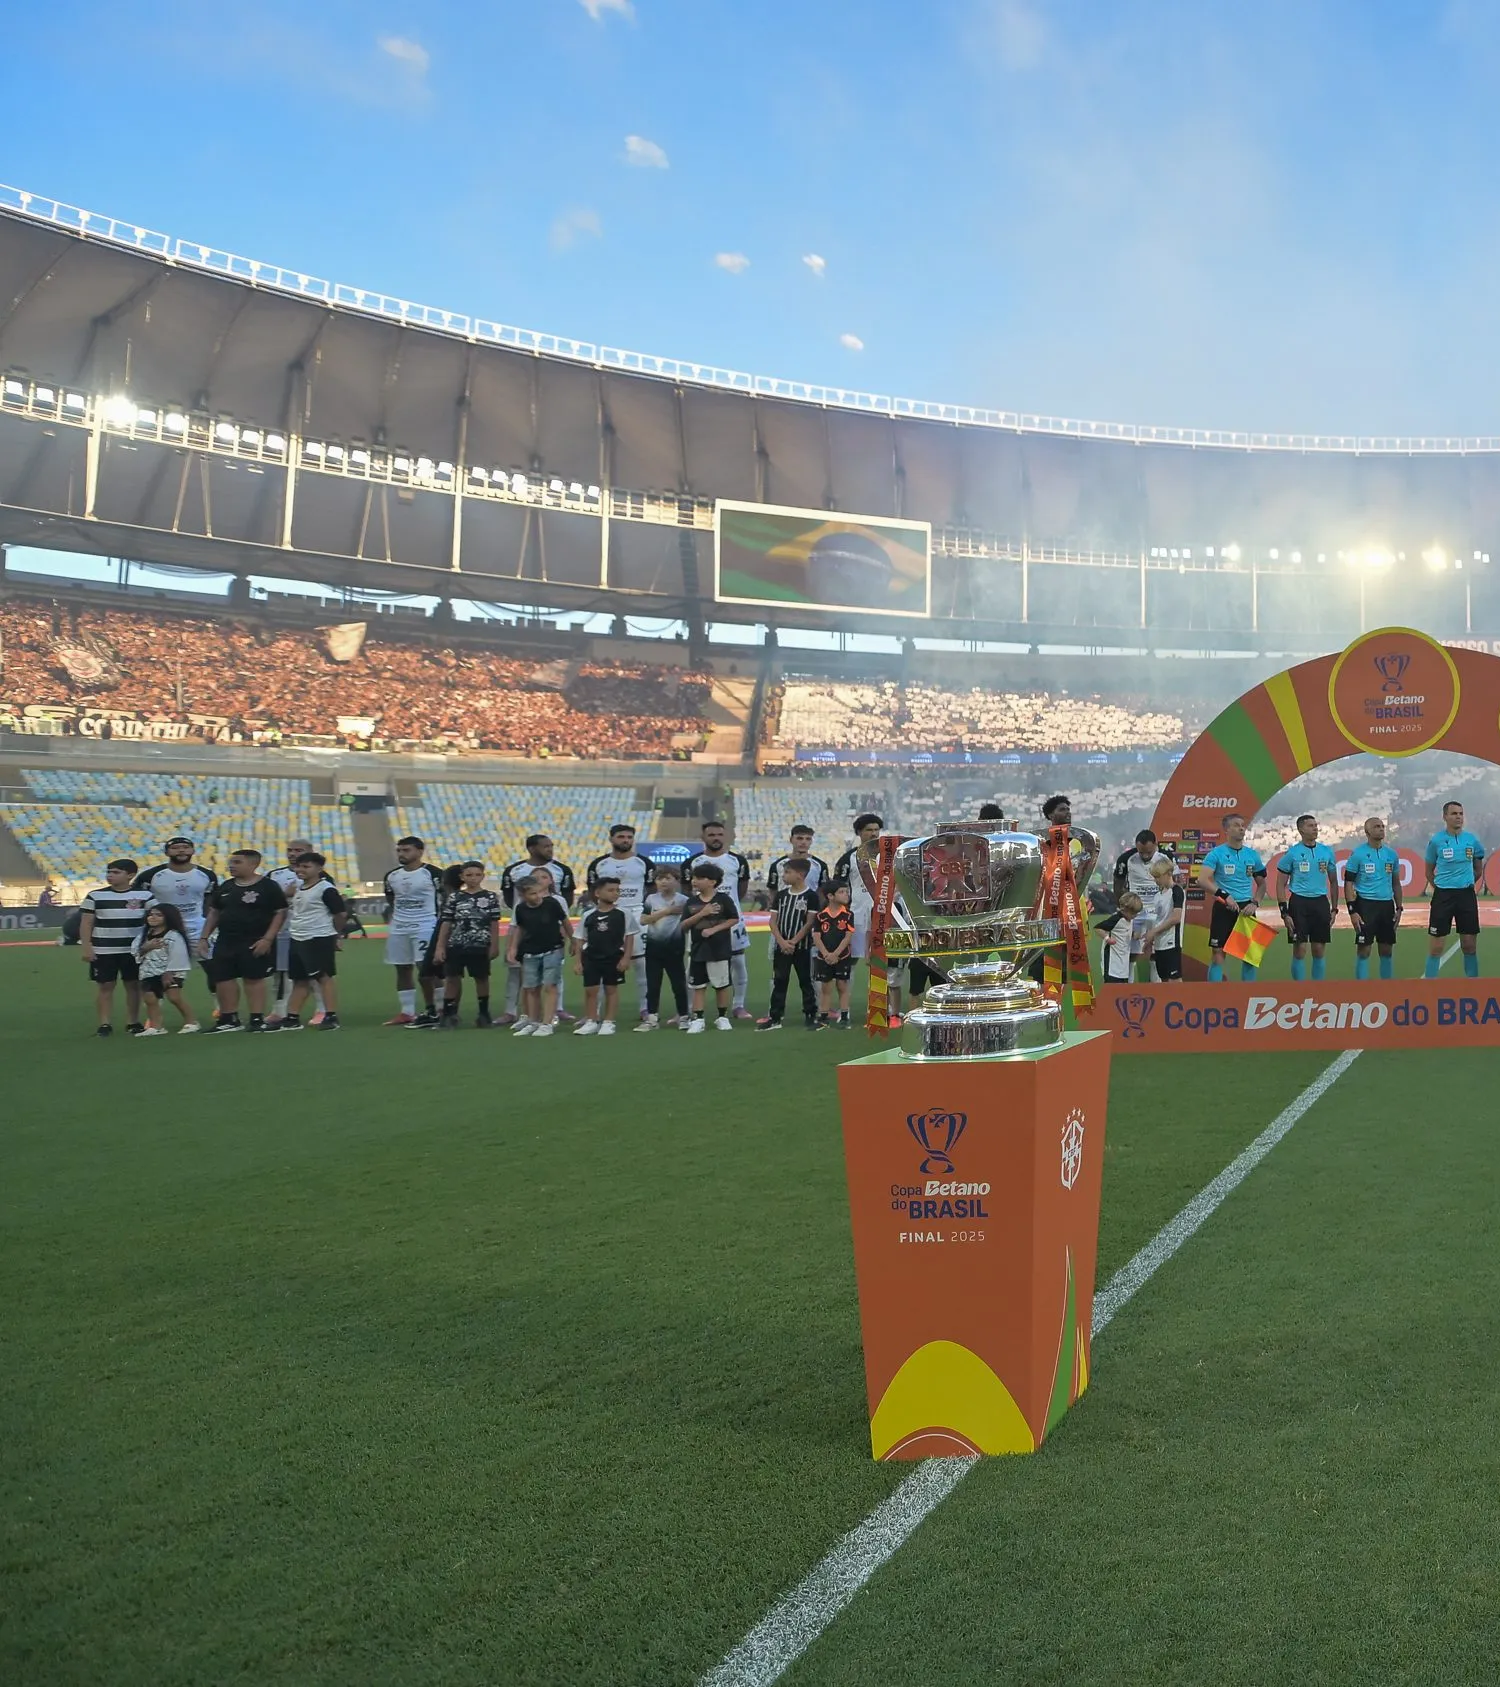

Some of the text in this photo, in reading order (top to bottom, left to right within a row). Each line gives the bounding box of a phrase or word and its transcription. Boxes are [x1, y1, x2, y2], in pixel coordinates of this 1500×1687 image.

[1364, 695, 1425, 708] Copa Betano
[1364, 705, 1424, 719] do BRASIL
[1369, 724, 1422, 734] FINAL 2025
[1182, 794, 1238, 809] Betano
[877, 876, 890, 914] Betano
[1049, 867, 1062, 906] Betano
[1065, 893, 1078, 930] Betano
[1164, 1001, 1239, 1034] Copa
[1243, 996, 1389, 1030] Betano
[1392, 998, 1429, 1026] do
[890, 1180, 991, 1199] Copa Betano
[891, 1198, 989, 1220] do BRASIL
[899, 1230, 985, 1244] FINAL 2025
